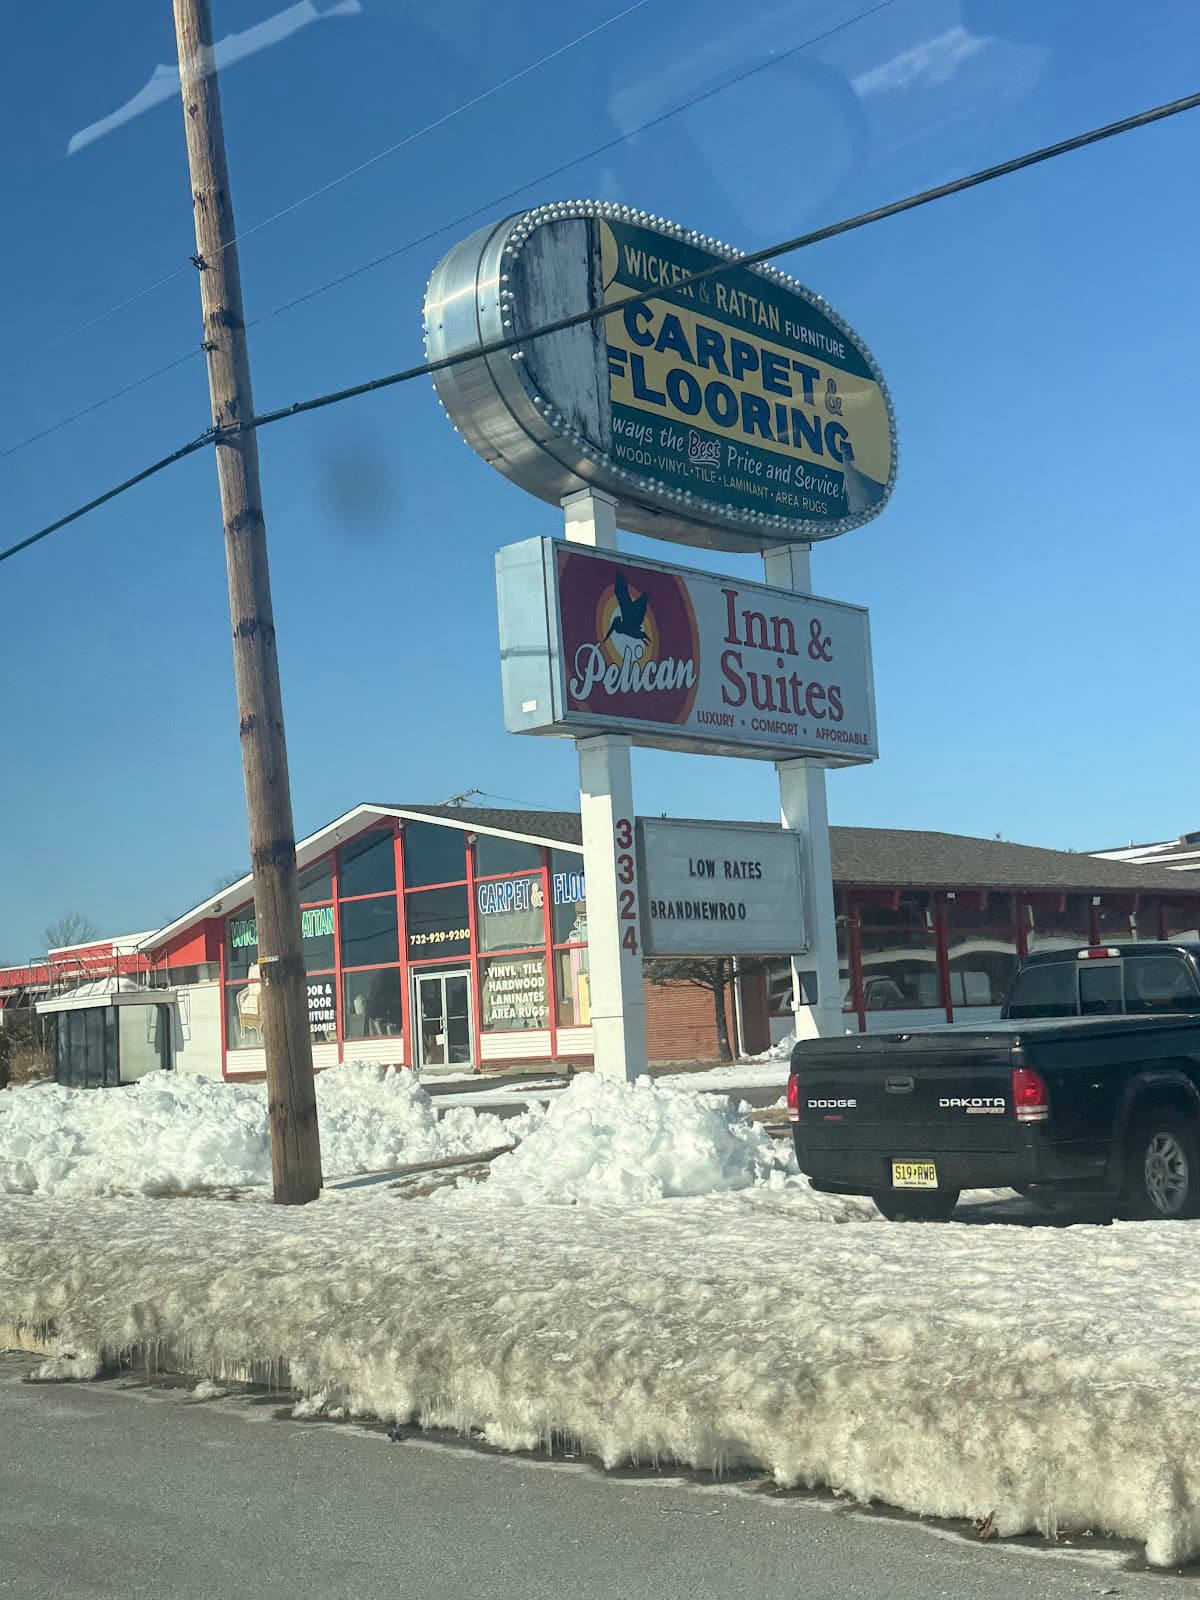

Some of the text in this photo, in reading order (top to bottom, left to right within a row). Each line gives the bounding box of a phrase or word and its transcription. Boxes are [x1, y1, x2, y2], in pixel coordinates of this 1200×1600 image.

[624, 244, 694, 298] WICKER
[715, 281, 780, 333] RATTAN
[785, 320, 846, 360] FURNITURE
[623, 300, 844, 416] CARPET &
[606, 344, 855, 464] FLOORING
[612, 417, 654, 447] ways
[660, 427, 684, 452] the
[688, 429, 721, 460] Best
[727, 445, 763, 476] Price
[766, 464, 791, 484] and
[615, 444, 828, 514] WOOD VINYL TILE LAMINANT AREA RUGS
[721, 588, 833, 662] Inn &
[569, 642, 697, 701] Pelican
[720, 649, 844, 722] Suites
[697, 709, 869, 746] LUXURY COMFORT AFFORDABLE
[689, 858, 762, 880] LOW RATES
[478, 871, 587, 914] CARPET & FLOO
[231, 907, 335, 947] WIC ATTAN
[410, 928, 471, 946] 732-929-9200
[487, 962, 543, 978] VINYL TILE
[488, 976, 545, 992] HARDWOOD
[308, 996, 332, 1009] DOOR
[491, 991, 545, 1006] LAMINATES
[491, 1005, 545, 1020] AREA RUGS
[309, 1009, 335, 1022] ITURE
[310, 1022, 336, 1033] SSORIES
[808, 1098, 857, 1108] DODGE
[939, 1098, 1005, 1107] DAKOTA
